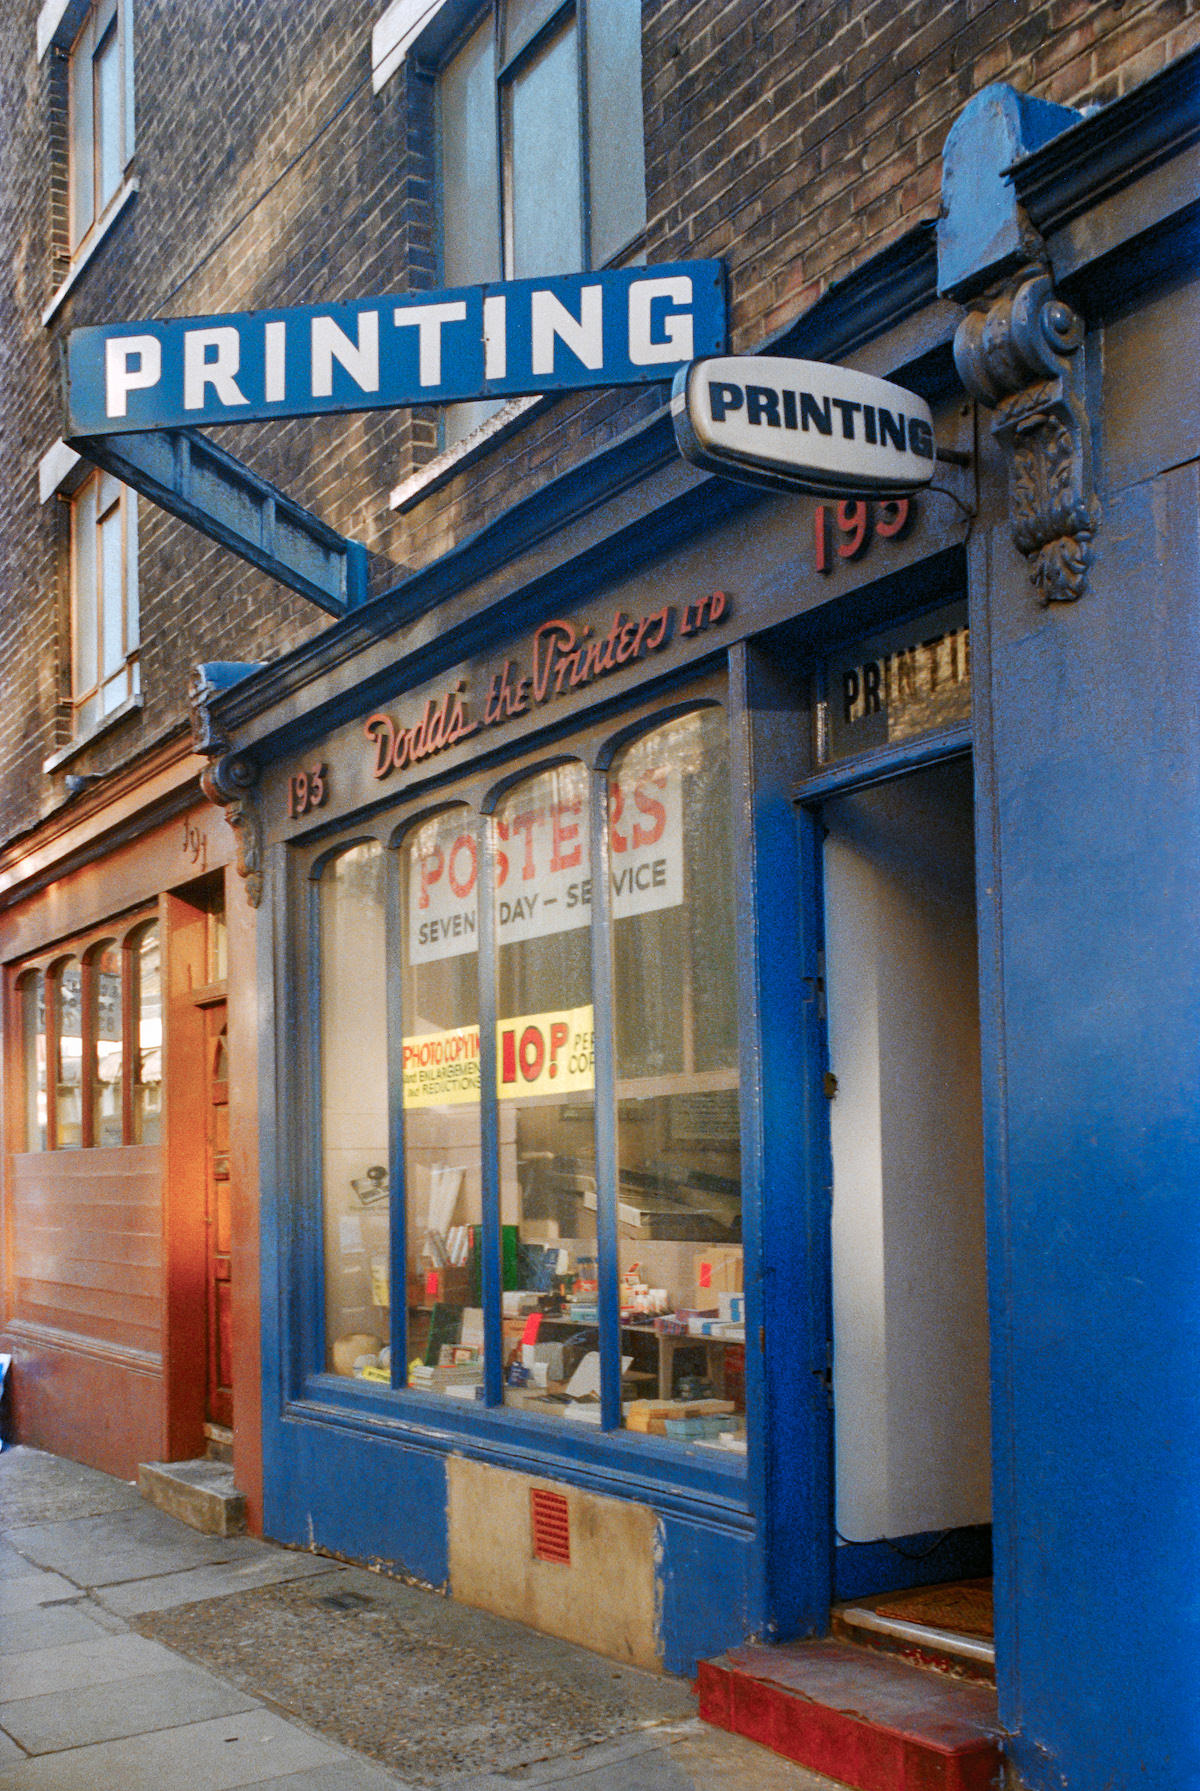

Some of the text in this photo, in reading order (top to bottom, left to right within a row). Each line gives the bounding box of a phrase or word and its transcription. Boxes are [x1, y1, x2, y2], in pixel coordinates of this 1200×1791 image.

[106, 275, 694, 418] PRINTING
[708, 381, 935, 460] PRINTING
[484, 659, 533, 724] the
[532, 605, 669, 702] Printers
[680, 590, 726, 636] LTD
[287, 763, 324, 818] 193
[418, 910, 476, 946] SEVEN
[499, 892, 539, 926] DAY
[567, 858, 667, 909] SEVICE
